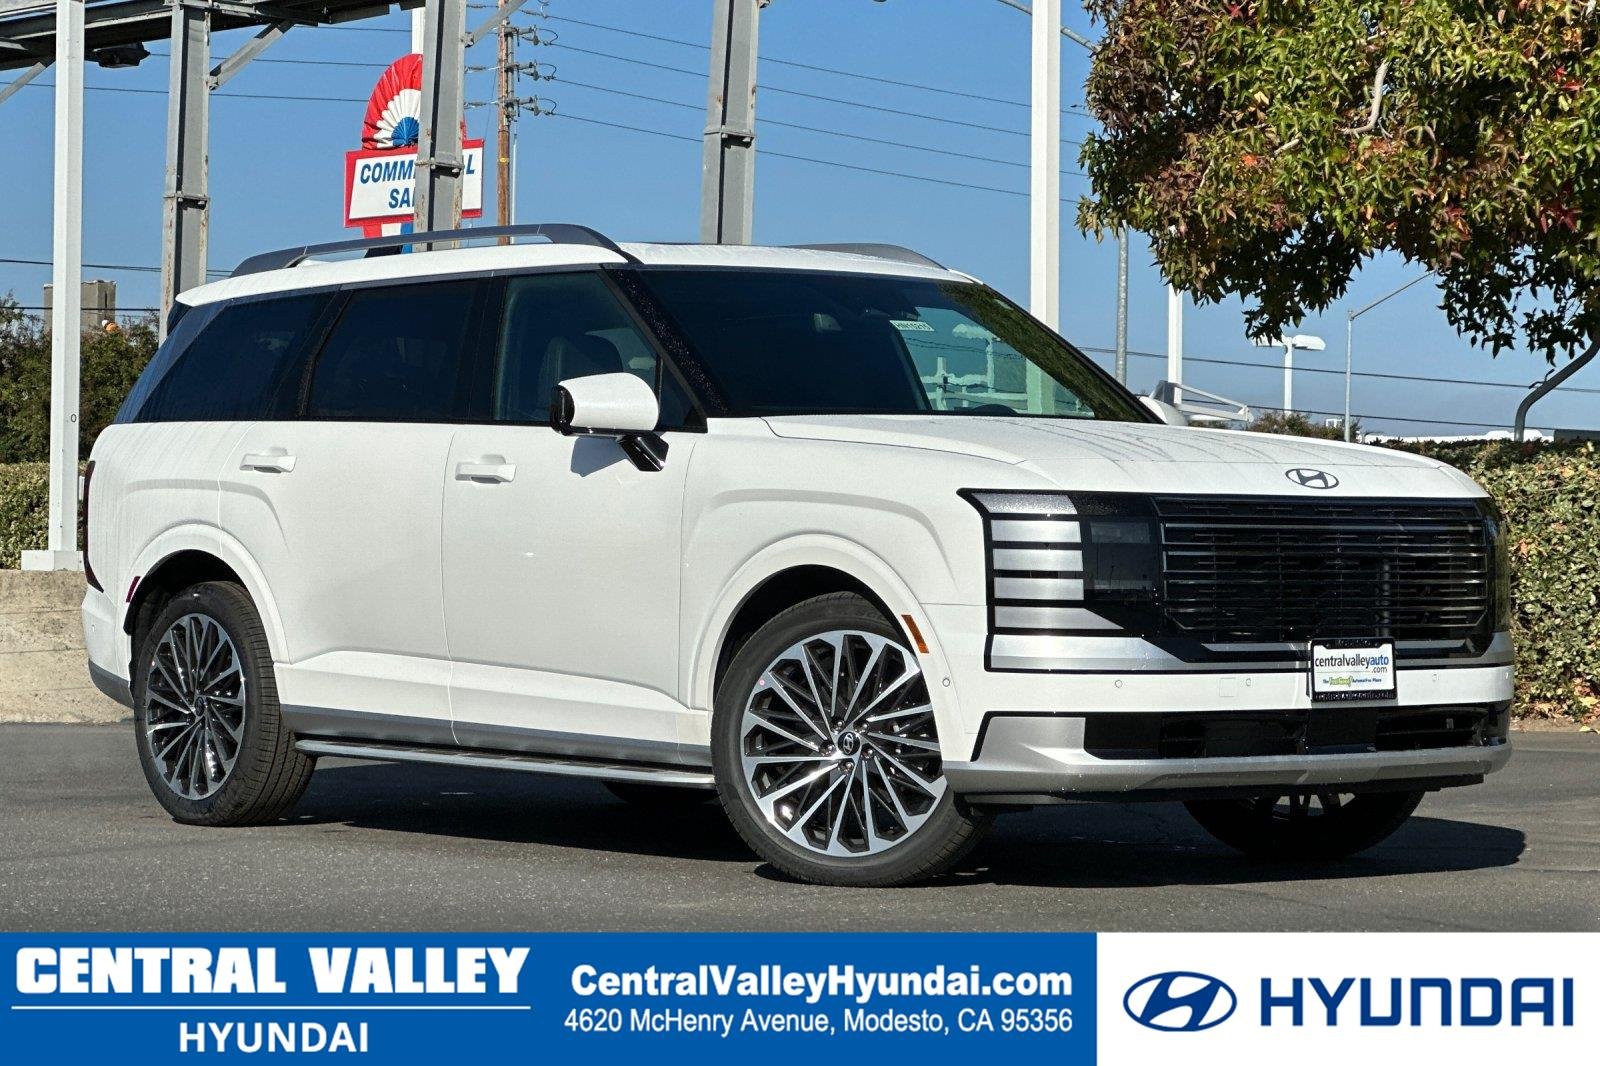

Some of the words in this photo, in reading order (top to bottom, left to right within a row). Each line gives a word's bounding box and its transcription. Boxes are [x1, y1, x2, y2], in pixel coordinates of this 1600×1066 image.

[360, 154, 475, 184] COMML
[1314, 653, 1389, 669] centralvalleyauto
[1371, 665, 1388, 674] .com
